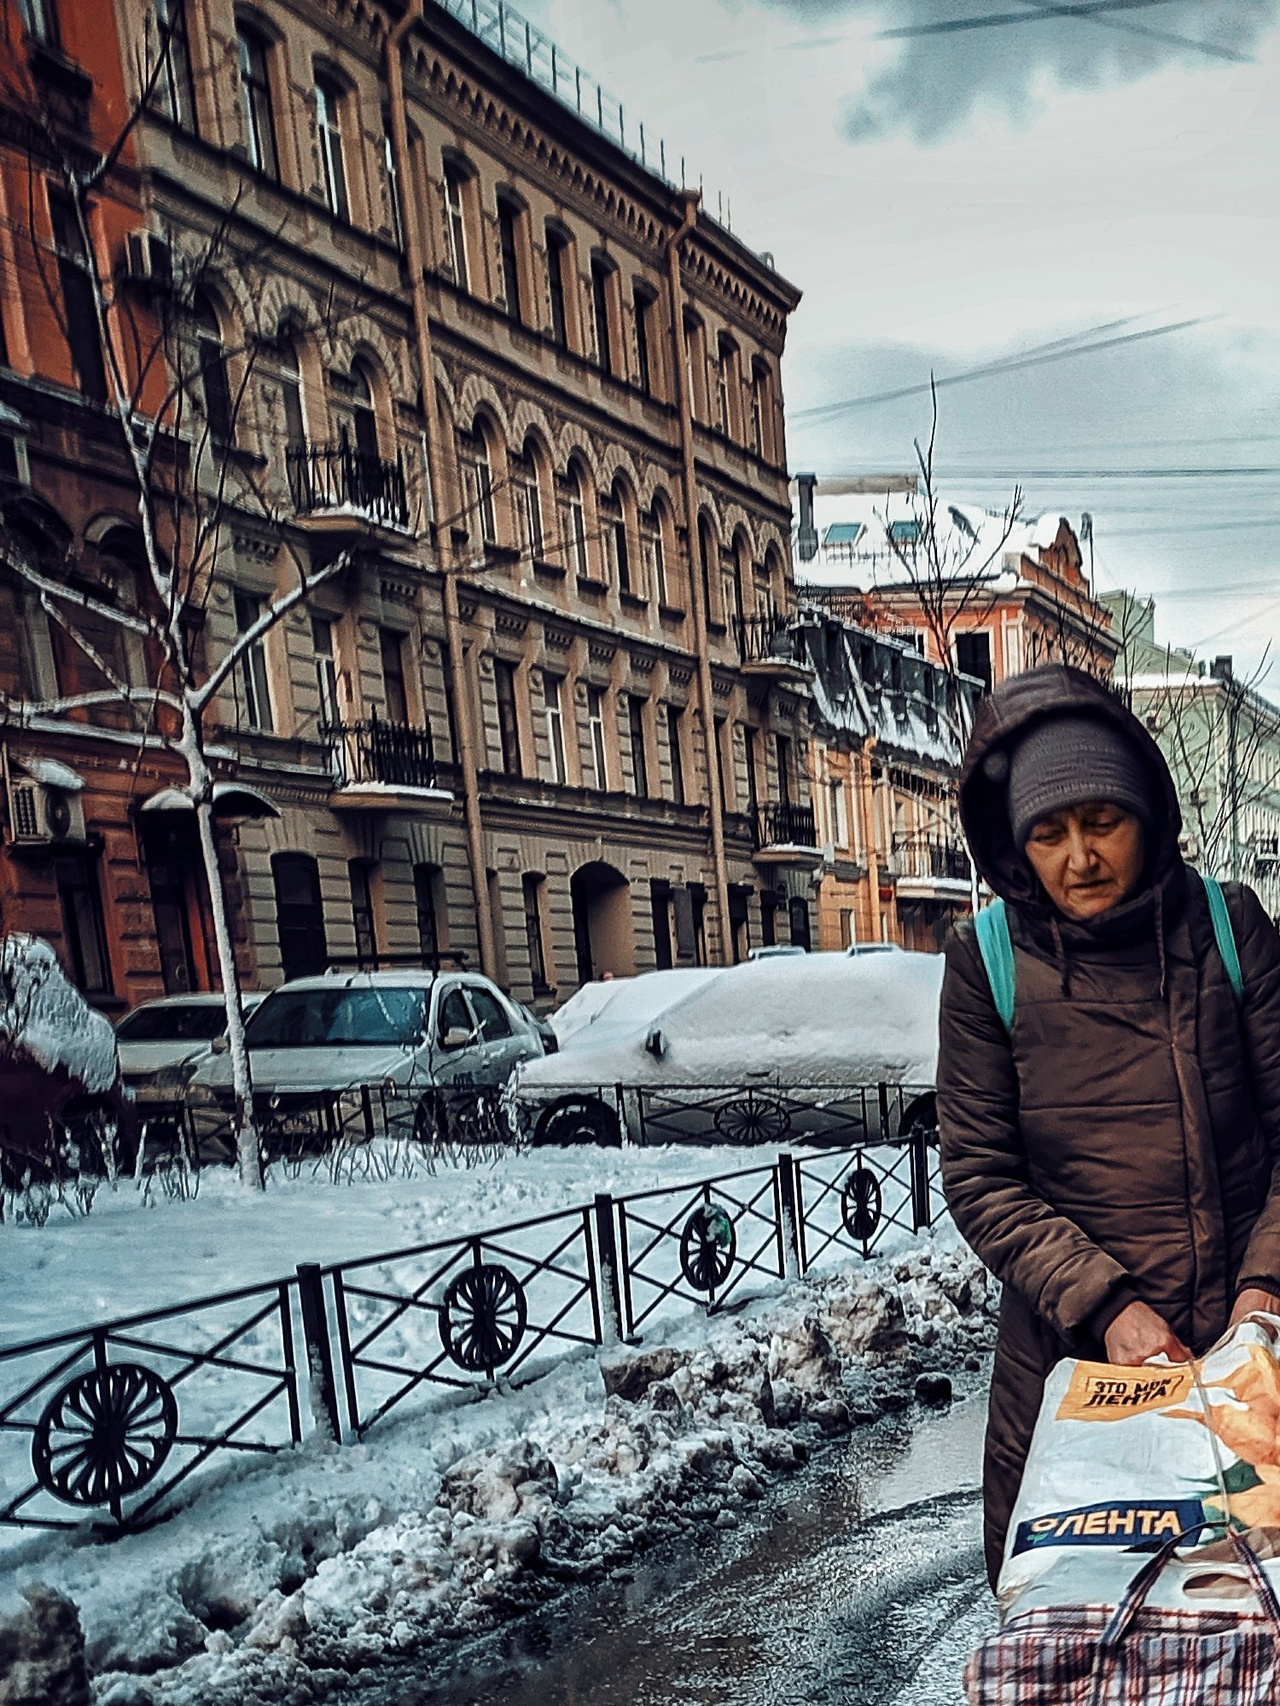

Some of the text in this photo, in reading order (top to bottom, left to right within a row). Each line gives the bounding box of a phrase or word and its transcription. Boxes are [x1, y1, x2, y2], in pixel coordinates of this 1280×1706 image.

[1083, 1386, 1166, 1407] ЛЕНТА
[1094, 1381, 1127, 1395] ЭТО
[1054, 1509, 1183, 1537] ЛЕНТА
